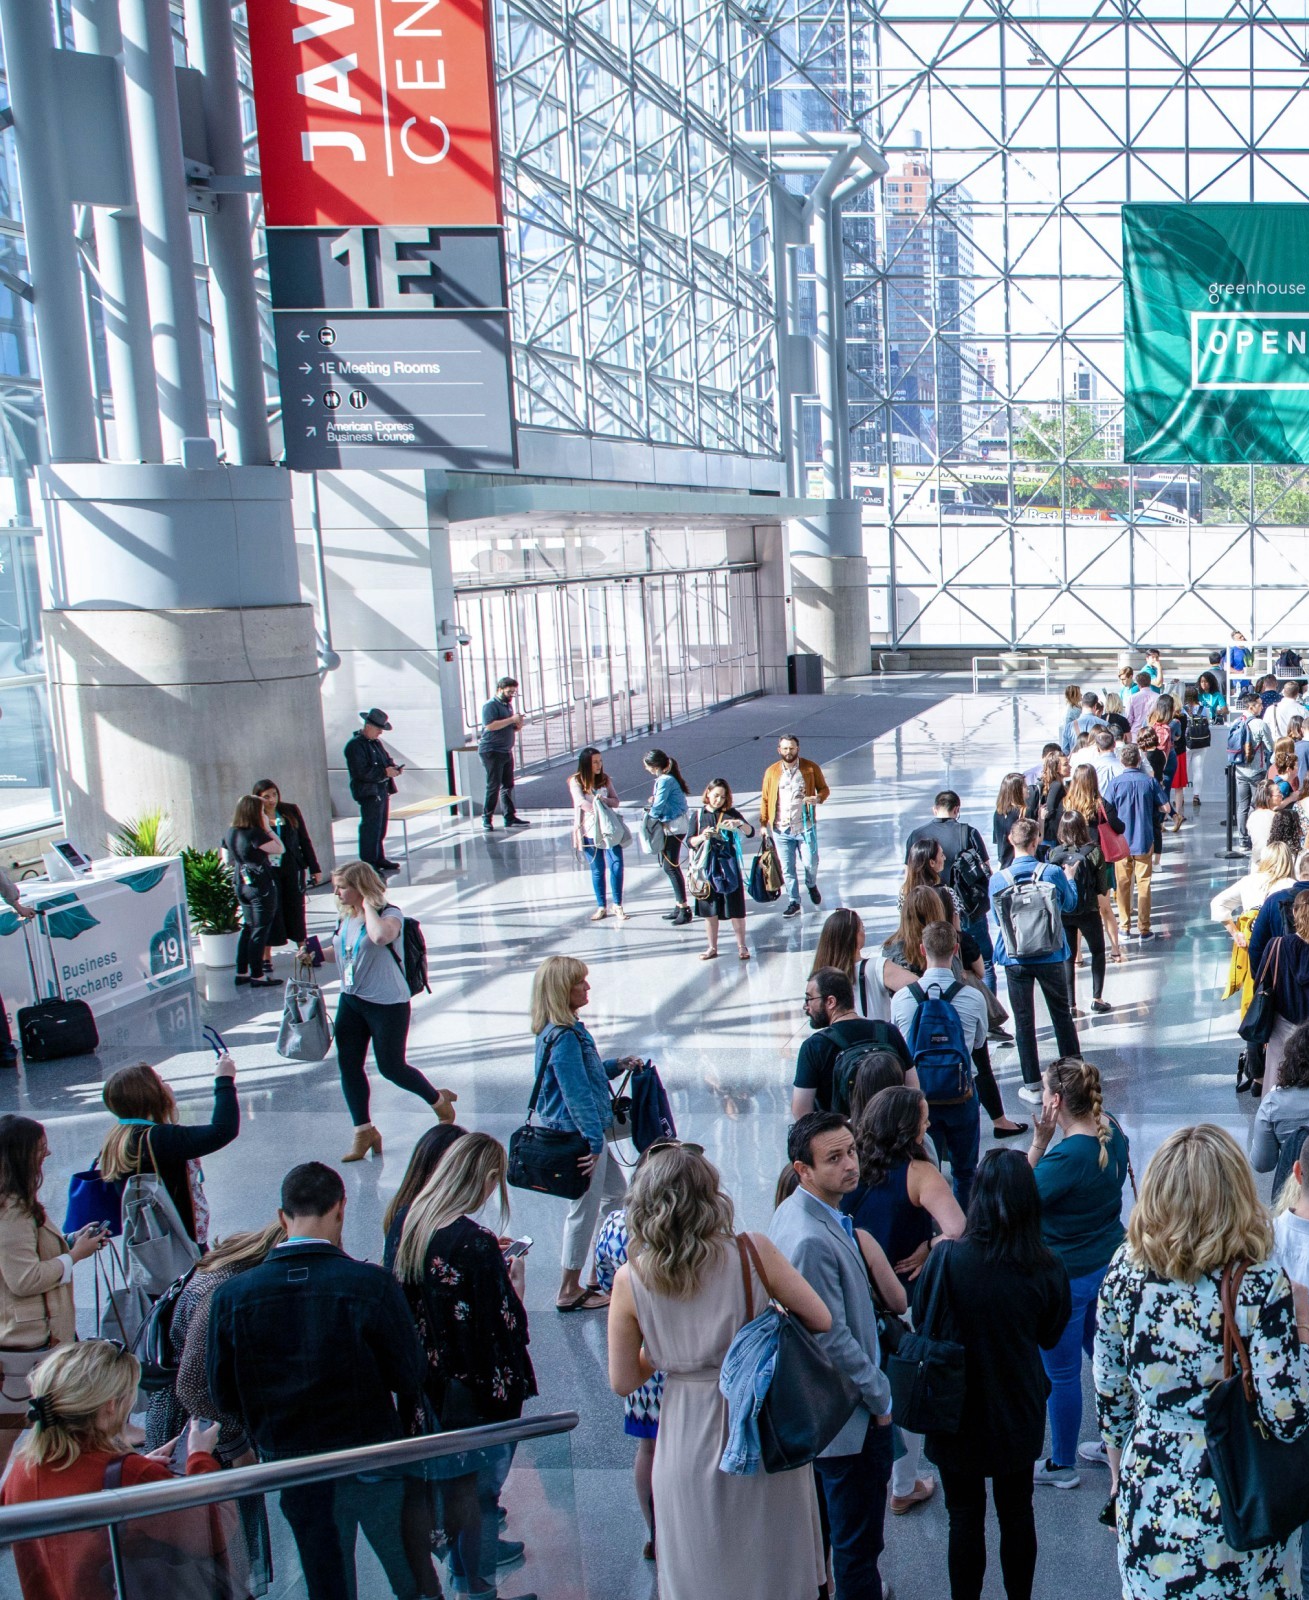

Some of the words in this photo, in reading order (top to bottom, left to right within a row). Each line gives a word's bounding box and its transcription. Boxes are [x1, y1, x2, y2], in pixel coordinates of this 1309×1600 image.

[330, 227, 435, 309] 1E
[1208, 281, 1306, 305] greenhouse
[1208, 330, 1307, 355] OPEN
[319, 361, 336, 374] 1E
[339, 361, 391, 377] Meeting
[393, 361, 441, 374] Rooms
[326, 421, 373, 432] American
[374, 421, 415, 434] Express
[327, 431, 373, 442] Business
[376, 431, 416, 443] Lounge
[158, 937, 180, 965] 19
[62, 951, 118, 981] Business
[64, 969, 124, 1002] Exchange
